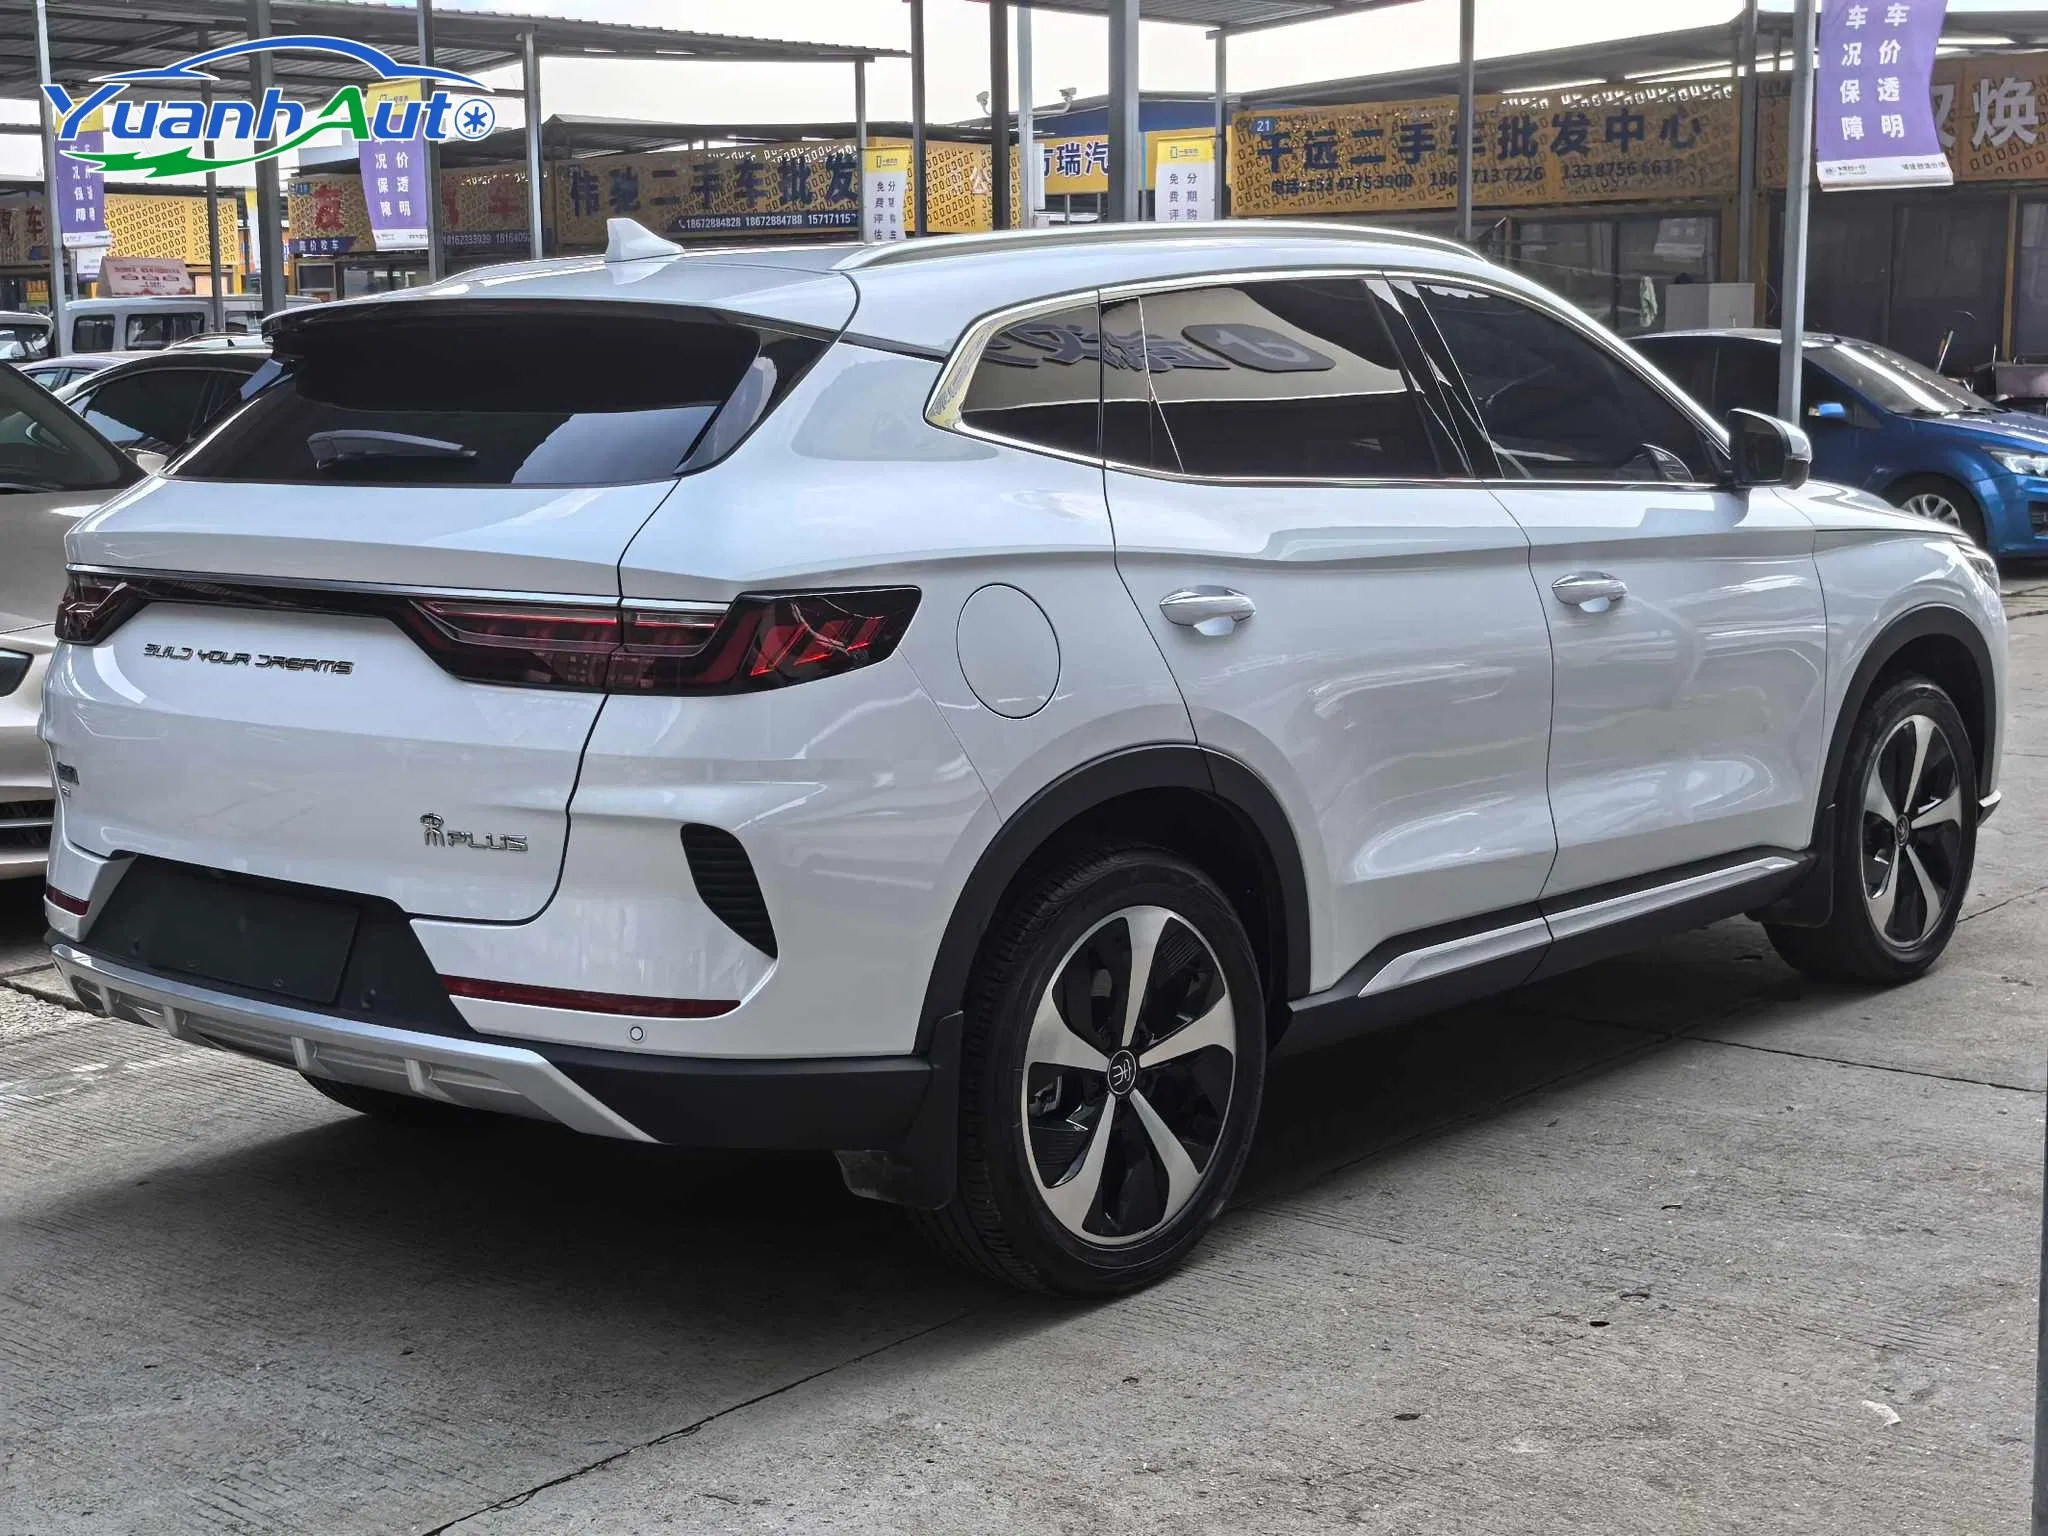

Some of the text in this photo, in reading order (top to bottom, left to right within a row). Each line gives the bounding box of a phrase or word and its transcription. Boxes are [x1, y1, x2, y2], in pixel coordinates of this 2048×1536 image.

[1840, 5, 1868, 140] 车况保障
[1877, 3, 1910, 138] 车价透明
[1256, 120, 1271, 132] 21
[374, 138, 392, 217] 况保障
[396, 138, 411, 217] 价透明
[144, 643, 355, 675] BUILD YOUR DREAMS
